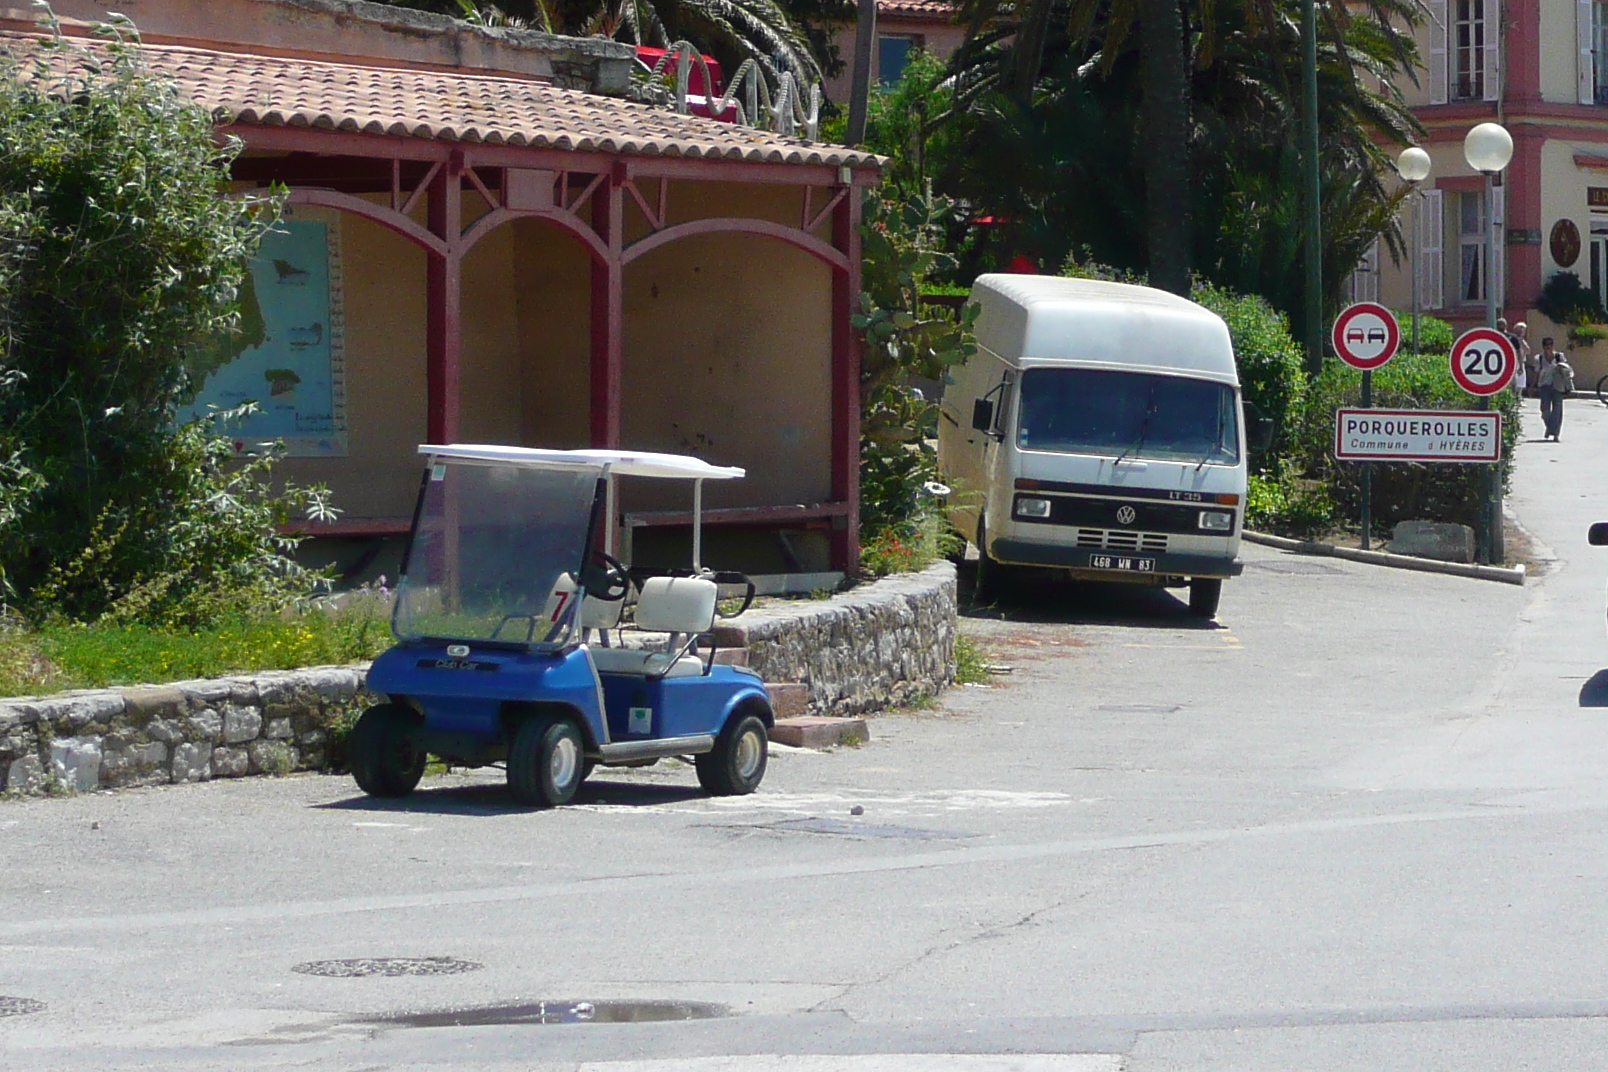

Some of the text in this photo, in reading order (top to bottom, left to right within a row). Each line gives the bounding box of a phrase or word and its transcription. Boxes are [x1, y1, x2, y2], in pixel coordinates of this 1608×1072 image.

[1464, 349, 1503, 375] 20
[1347, 420, 1489, 437] PORQUEROLLES
[1351, 438, 1409, 450] Commune
[551, 591, 568, 622] 7
[435, 659, 479, 670] Club Car
